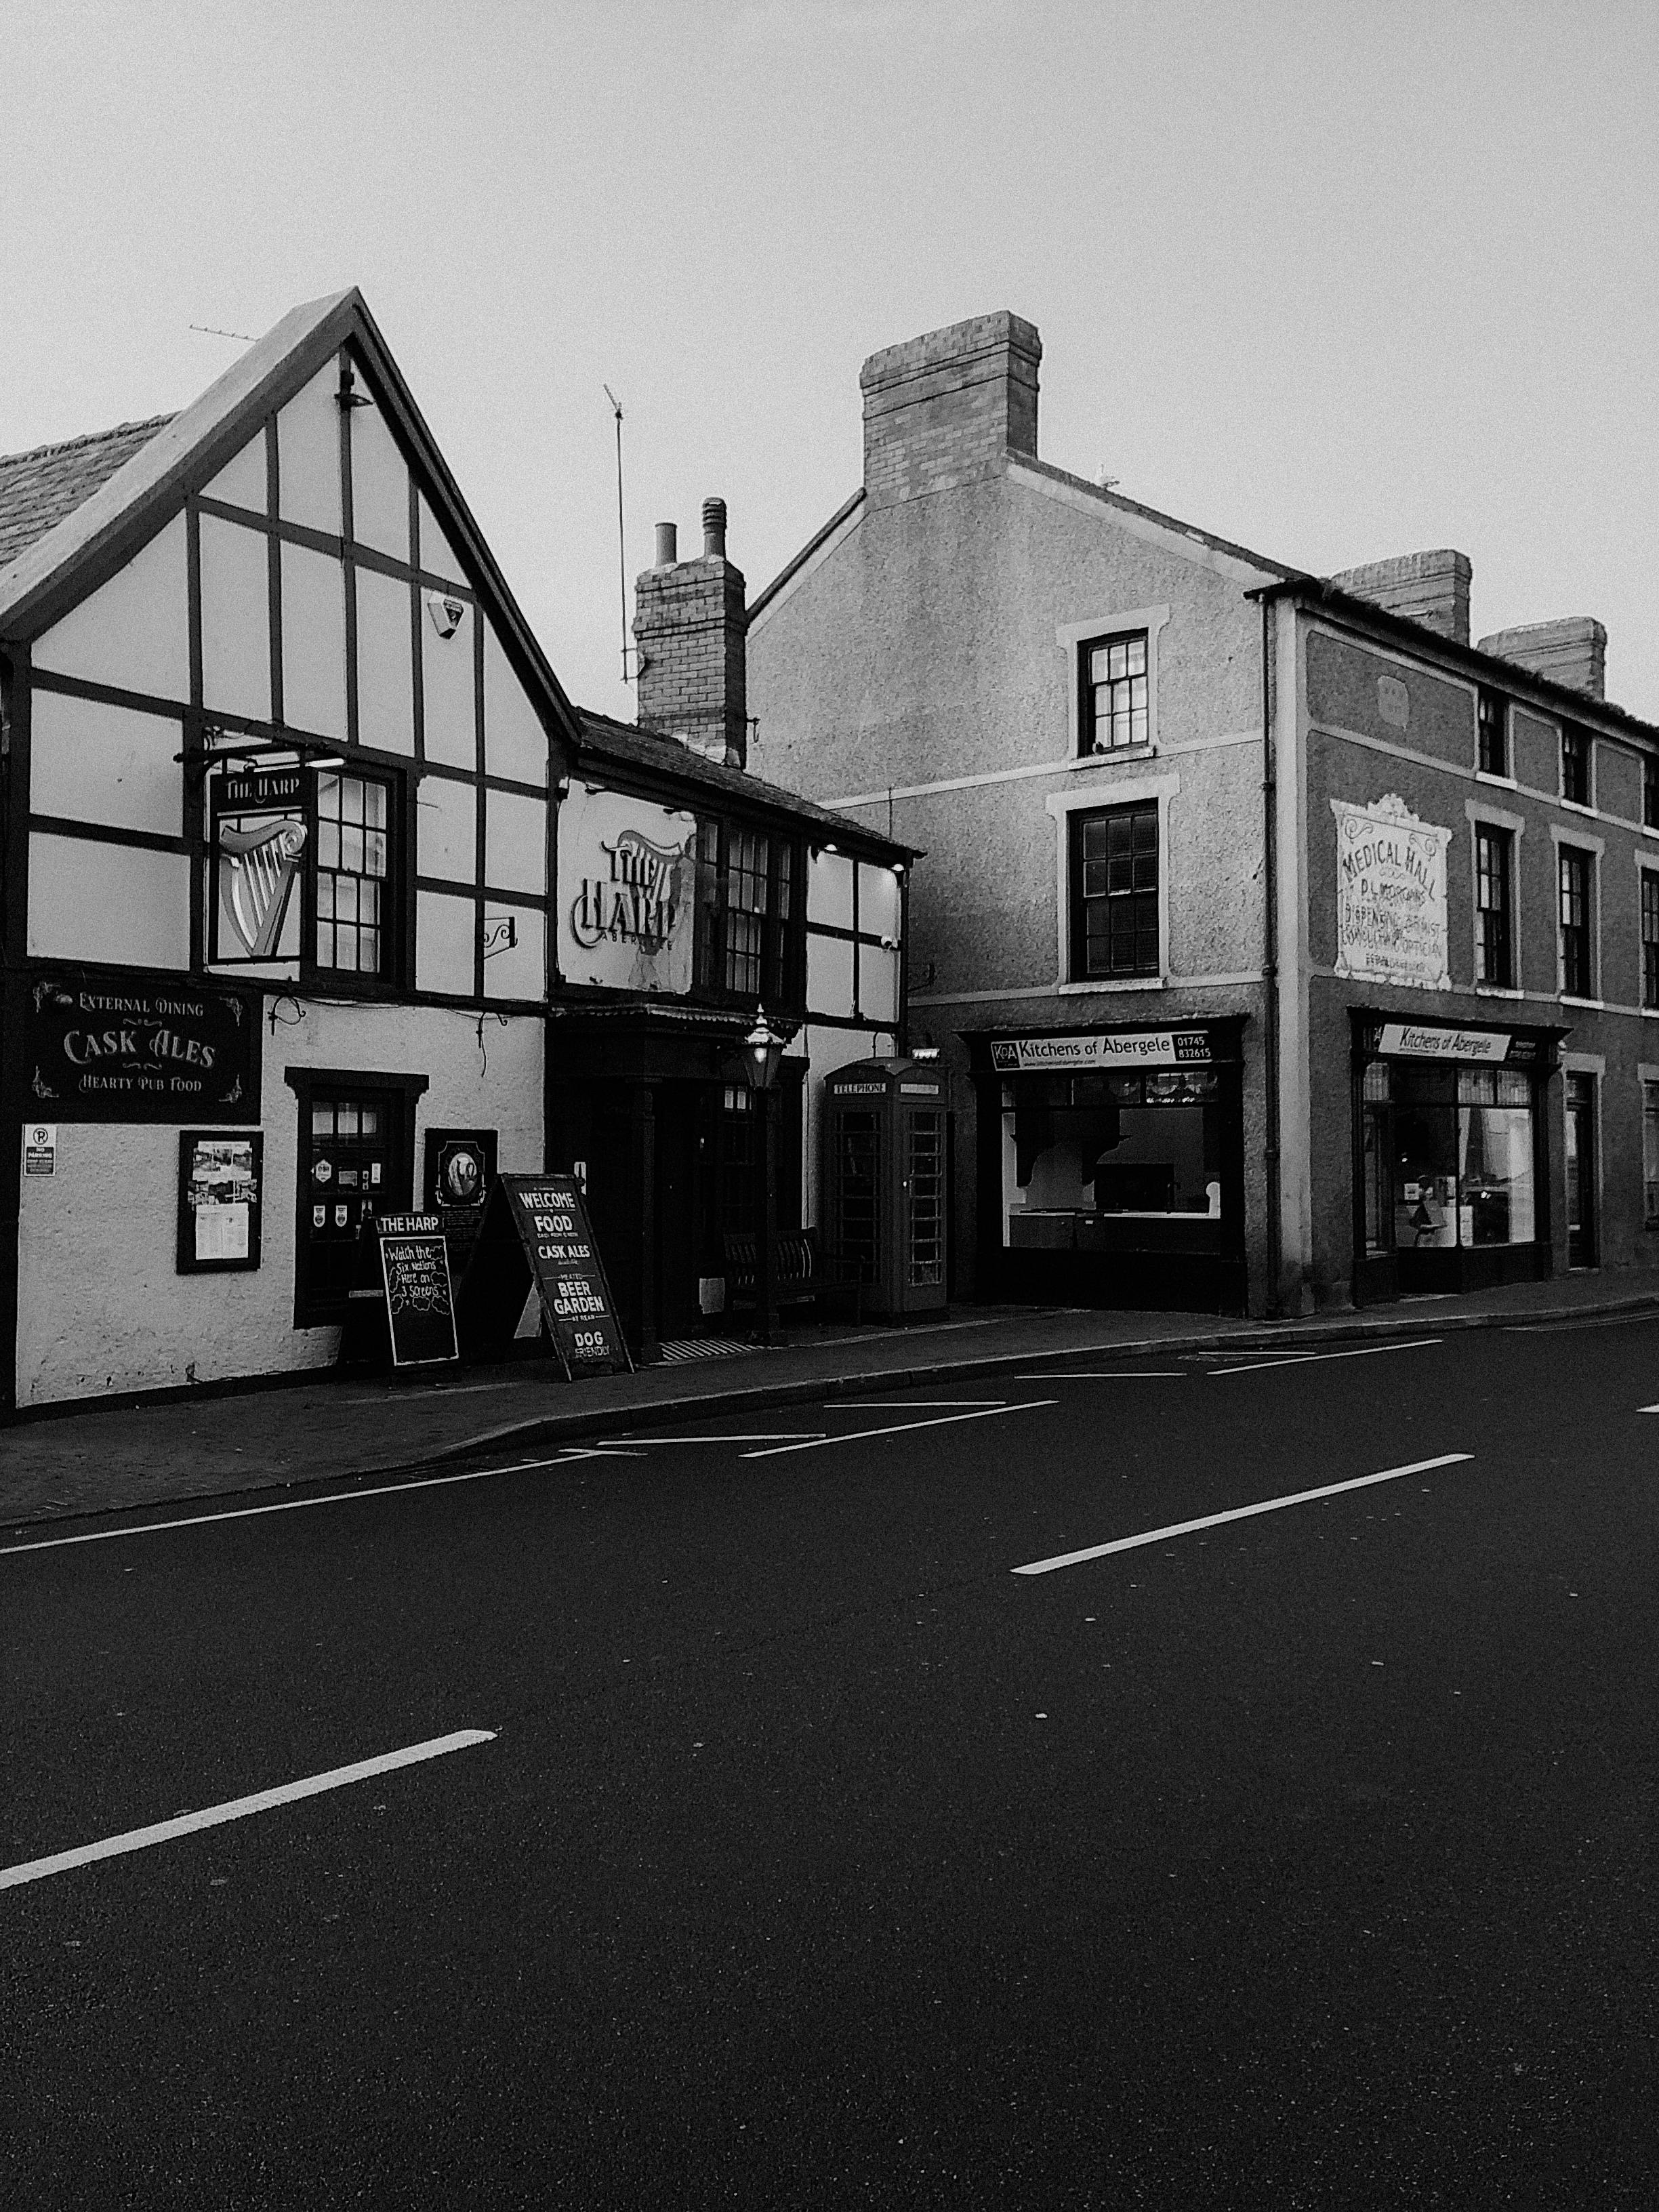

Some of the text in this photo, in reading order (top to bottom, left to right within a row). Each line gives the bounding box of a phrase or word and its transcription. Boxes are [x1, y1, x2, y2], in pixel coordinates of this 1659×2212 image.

[254, 778, 300, 804] HARP
[601, 841, 655, 888] THE
[1343, 840, 1401, 882] MEDICAL
[571, 878, 676, 949] HARP
[79, 992, 203, 1017] EXTERNAL DINING
[64, 1029, 215, 1068] CASK ALES
[1019, 1041, 1081, 1057] Kitchens
[1084, 1042, 1098, 1055] of
[1103, 1038, 1170, 1056] Abergele
[1177, 1036, 1205, 1046] 01745
[1399, 1027, 1441, 1050] Kitchens
[1442, 1036, 1452, 1050] of
[1452, 1034, 1492, 1056] Abergele
[1179, 1048, 1211, 1058] 832615
[79, 1074, 202, 1093] HEARTY PUB FOOD
[837, 1084, 884, 1094] TELEPHONE
[518, 1193, 575, 1208] WELCOME
[381, 1216, 438, 1231] THE HARP
[534, 1215, 573, 1232] FOOD
[388, 1245, 432, 1261] Watch the
[538, 1245, 590, 1258] CASK ALES
[396, 1263, 409, 1275] Six
[401, 1273, 430, 1284] Here on
[401, 1286, 407, 1297] 3
[557, 1282, 592, 1297] BEER
[554, 1296, 605, 1315] GARDEN
[574, 1332, 604, 1347] DOG
